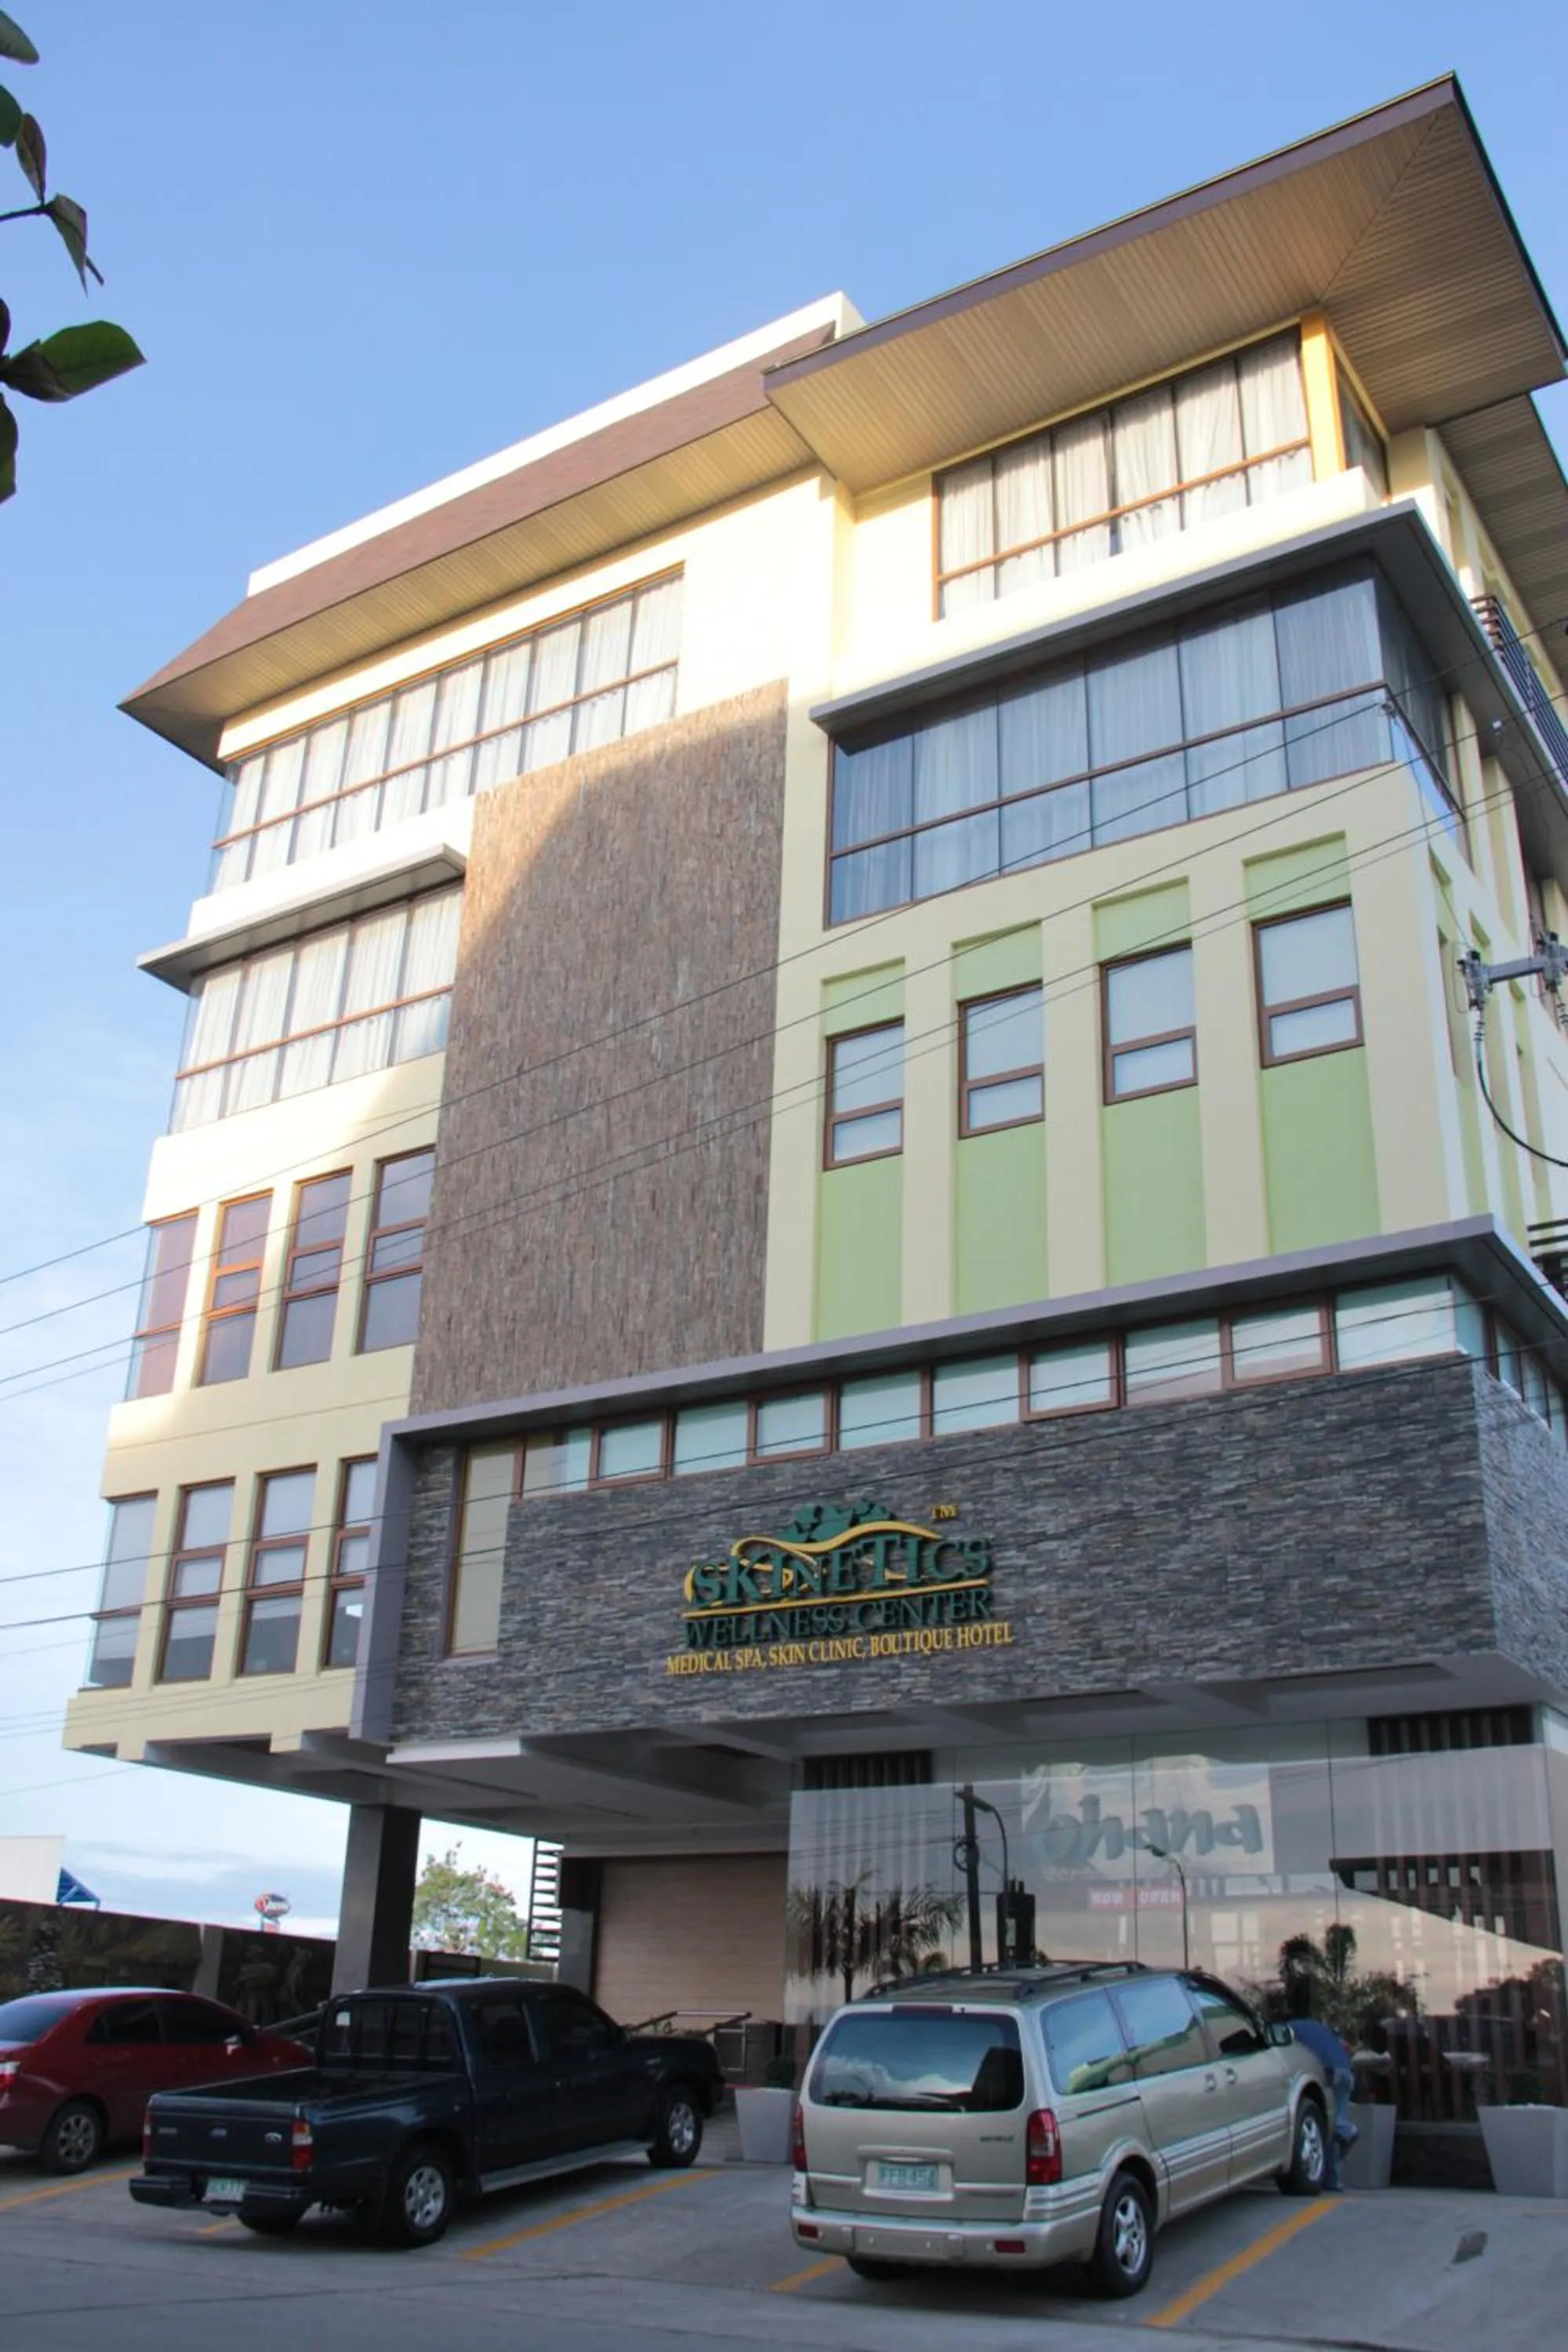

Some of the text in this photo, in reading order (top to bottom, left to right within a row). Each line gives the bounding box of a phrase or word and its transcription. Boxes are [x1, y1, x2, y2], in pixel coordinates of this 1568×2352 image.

[691, 1535, 991, 1607] SKINETICS
[666, 1650, 732, 1675] MEDICAL
[734, 1647, 767, 1671] SPA,
[768, 1643, 805, 1667] SKIN
[869, 1627, 954, 1657] BOUTIQUE
[956, 1621, 1014, 1648] HOTEL
[681, 1588, 993, 1649] WELLNESS CENTER
